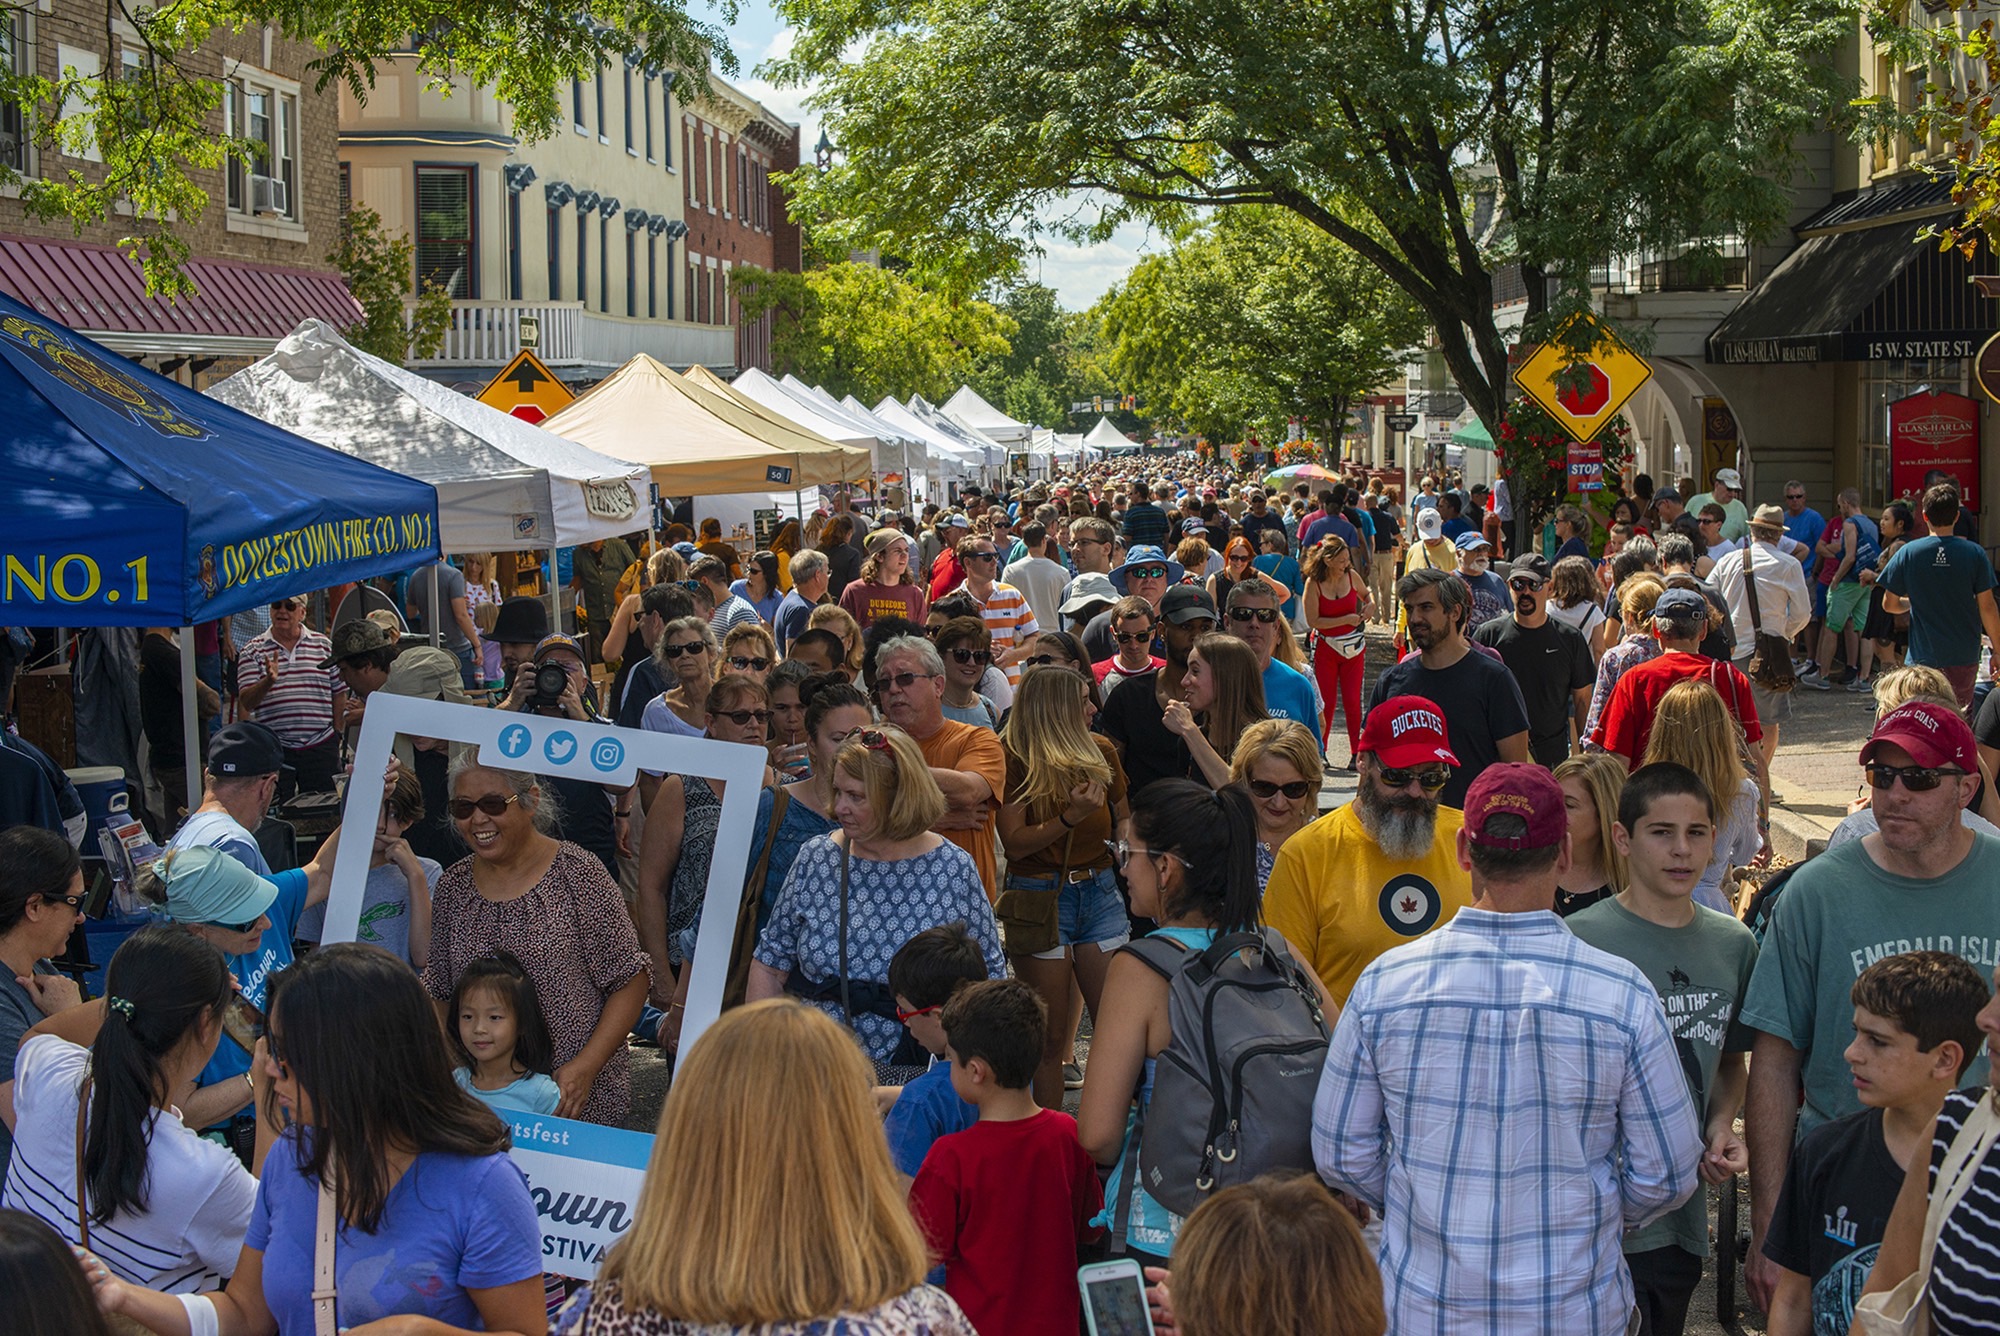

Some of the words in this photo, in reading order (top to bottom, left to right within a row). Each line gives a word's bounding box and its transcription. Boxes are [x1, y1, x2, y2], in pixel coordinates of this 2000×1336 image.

[1724, 341, 1781, 363] CLASS-HARLAN
[1868, 342, 1882, 359] 15
[1886, 342, 1902, 359] W.
[1905, 341, 1951, 358] STATE
[1953, 340, 1974, 357] ST.
[771, 471, 782, 480] 50
[1571, 463, 1599, 475] STOP
[222, 521, 341, 589] DOYLESTOWN
[343, 517, 372, 560] FIRE
[373, 515, 399, 554] CO.
[400, 512, 432, 551] NO.1
[3, 553, 149, 603] NO.1
[867, 609, 873, 617] &
[870, 599, 907, 610] DUNGEONS
[1268, 708, 1289, 719] wn
[1391, 709, 1443, 738] BUCKEYES
[1913, 709, 1940, 733] COAST
[1667, 995, 1685, 1013] ON
[1284, 1068, 1314, 1077] Columbia
[512, 1122, 570, 1146] tsfest
[524, 1174, 633, 1233] own
[540, 1234, 607, 1264] STIVA
